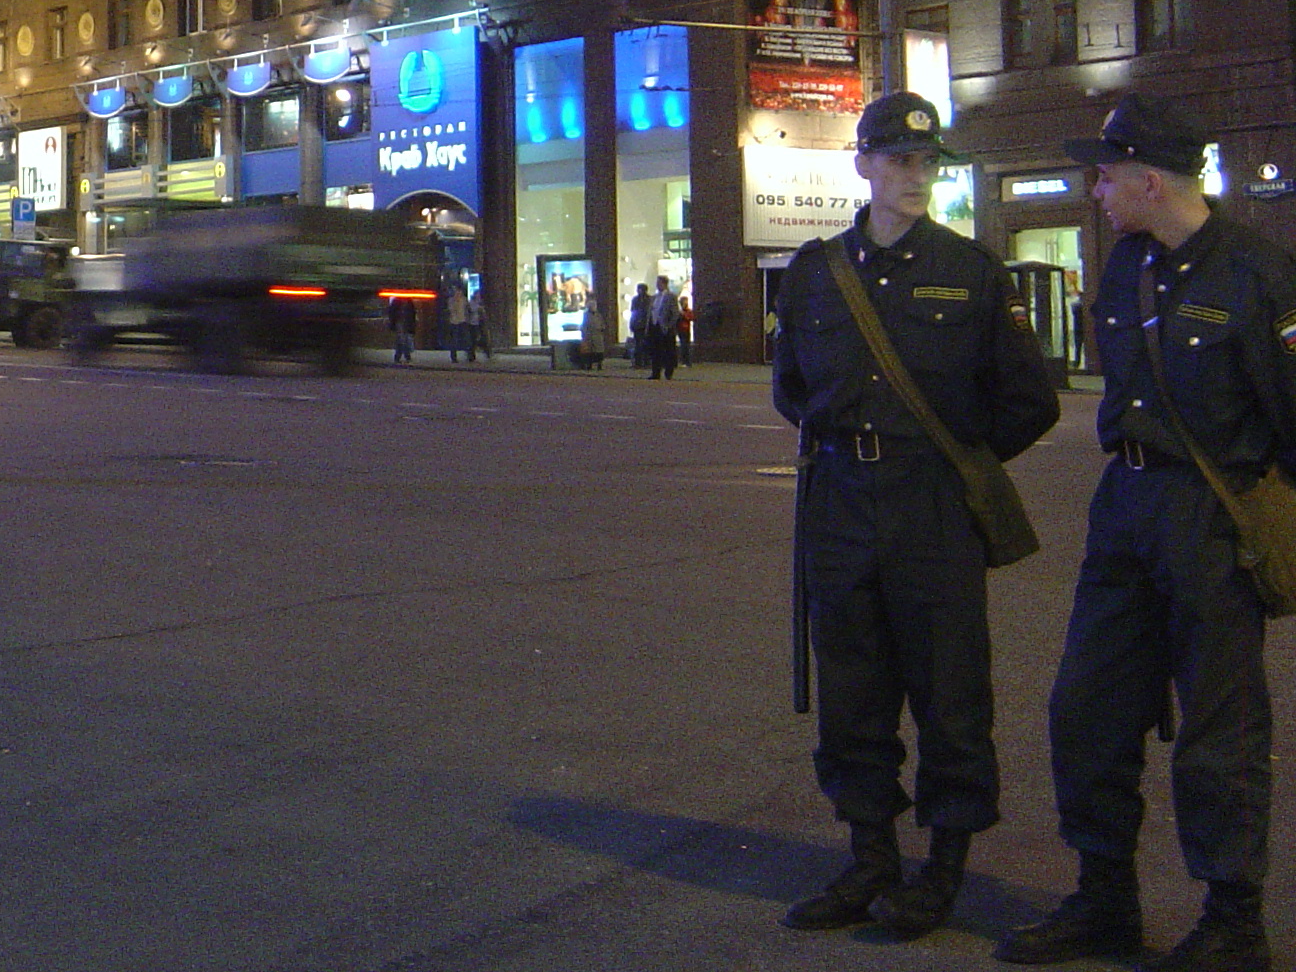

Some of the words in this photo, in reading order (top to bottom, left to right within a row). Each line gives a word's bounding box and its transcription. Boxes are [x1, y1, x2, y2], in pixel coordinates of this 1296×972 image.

[379, 121, 467, 142] РЕСТОРАН
[379, 143, 423, 176] Краб
[425, 140, 467, 171] Хаус
[19, 200, 32, 220] P
[755, 193, 786, 207] 095
[794, 195, 824, 208] 540
[829, 197, 848, 209] 77
[769, 216, 854, 228] НЕДВИЖИМОСТ
